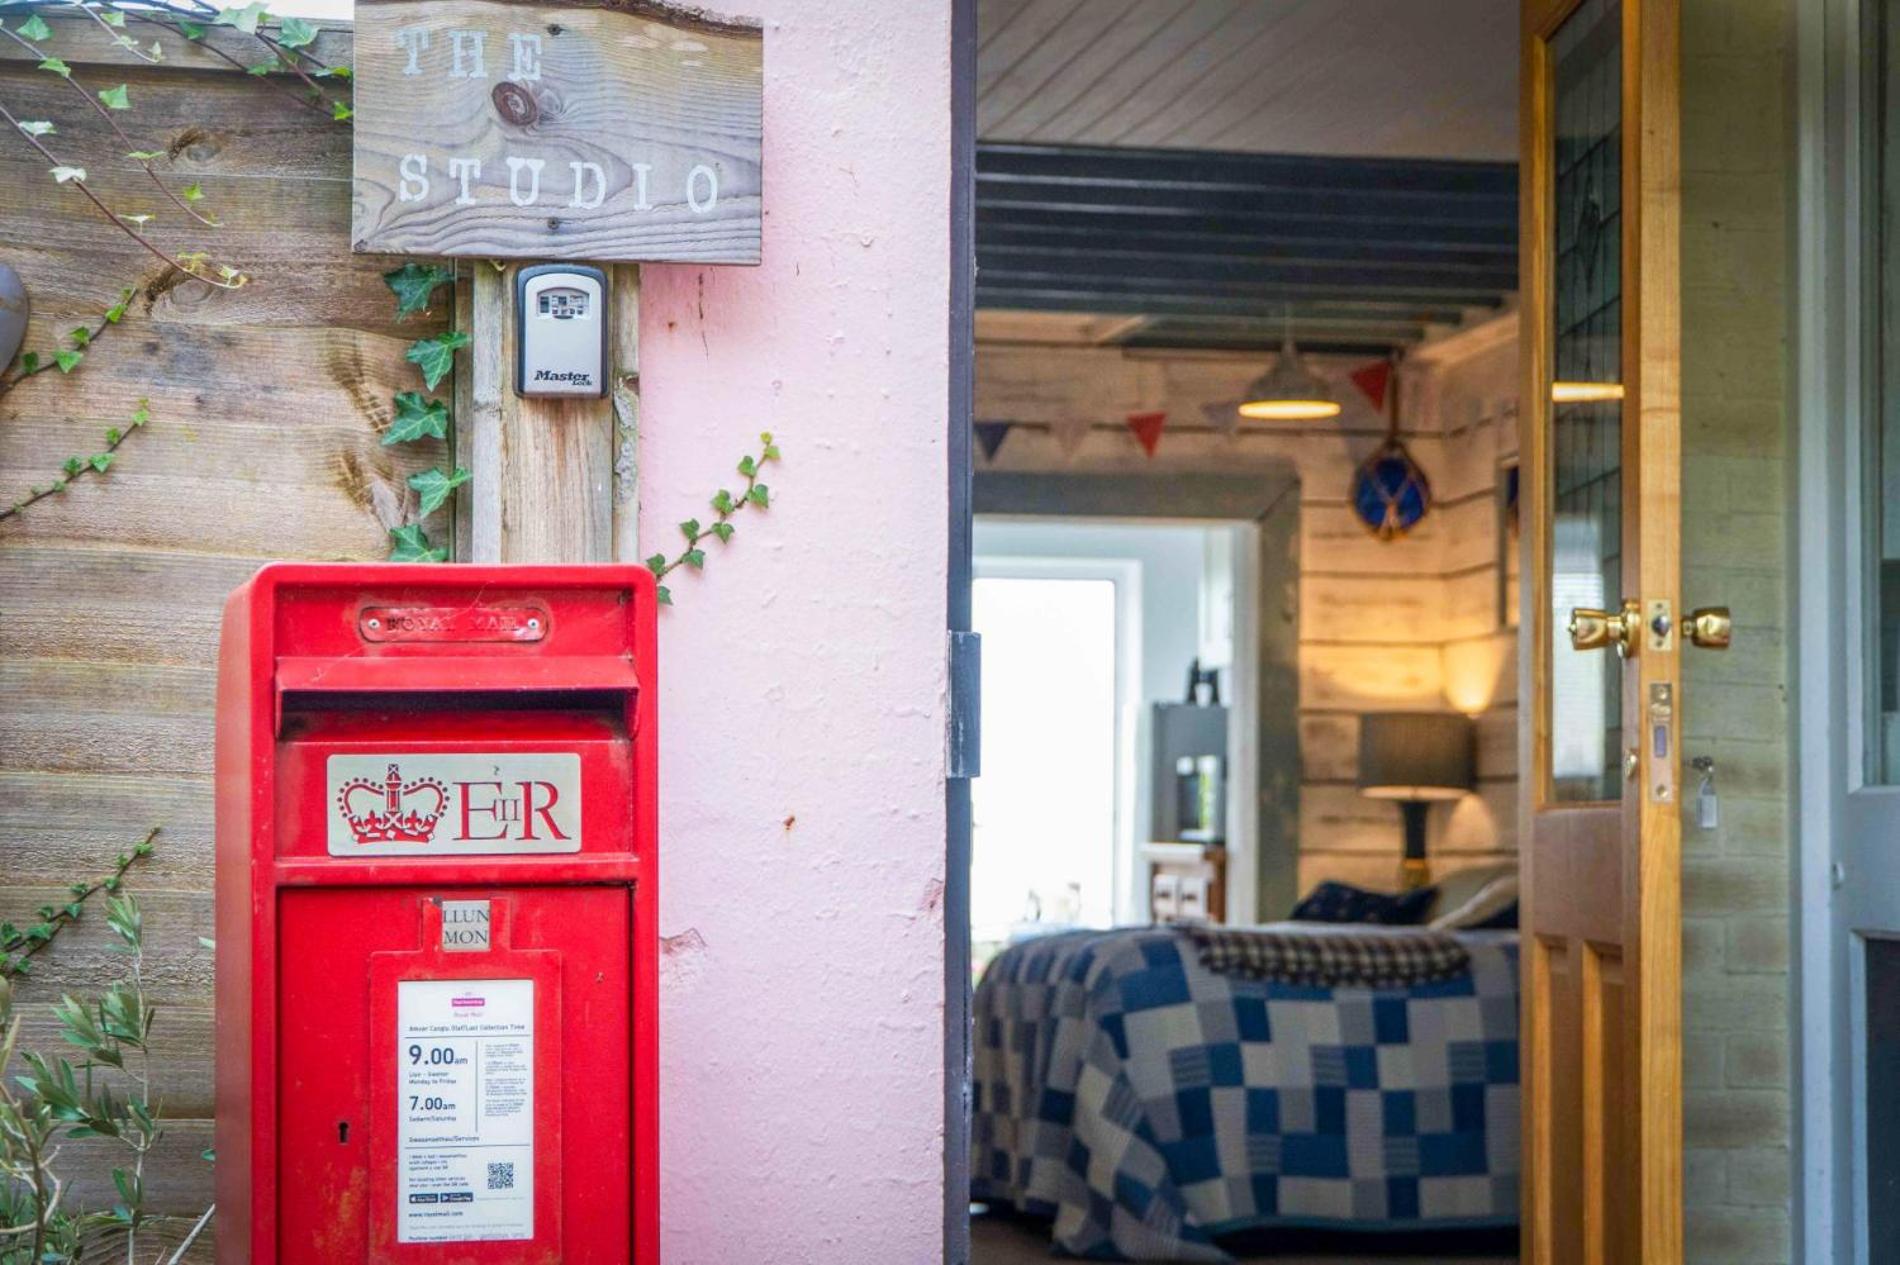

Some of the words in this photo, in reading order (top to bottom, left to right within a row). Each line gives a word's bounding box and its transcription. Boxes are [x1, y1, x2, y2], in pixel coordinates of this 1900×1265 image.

[395, 26, 543, 81] THE
[399, 153, 719, 214] STUDIO
[534, 369, 590, 381] Master
[443, 909, 490, 924] LLUN
[443, 930, 489, 945] MON
